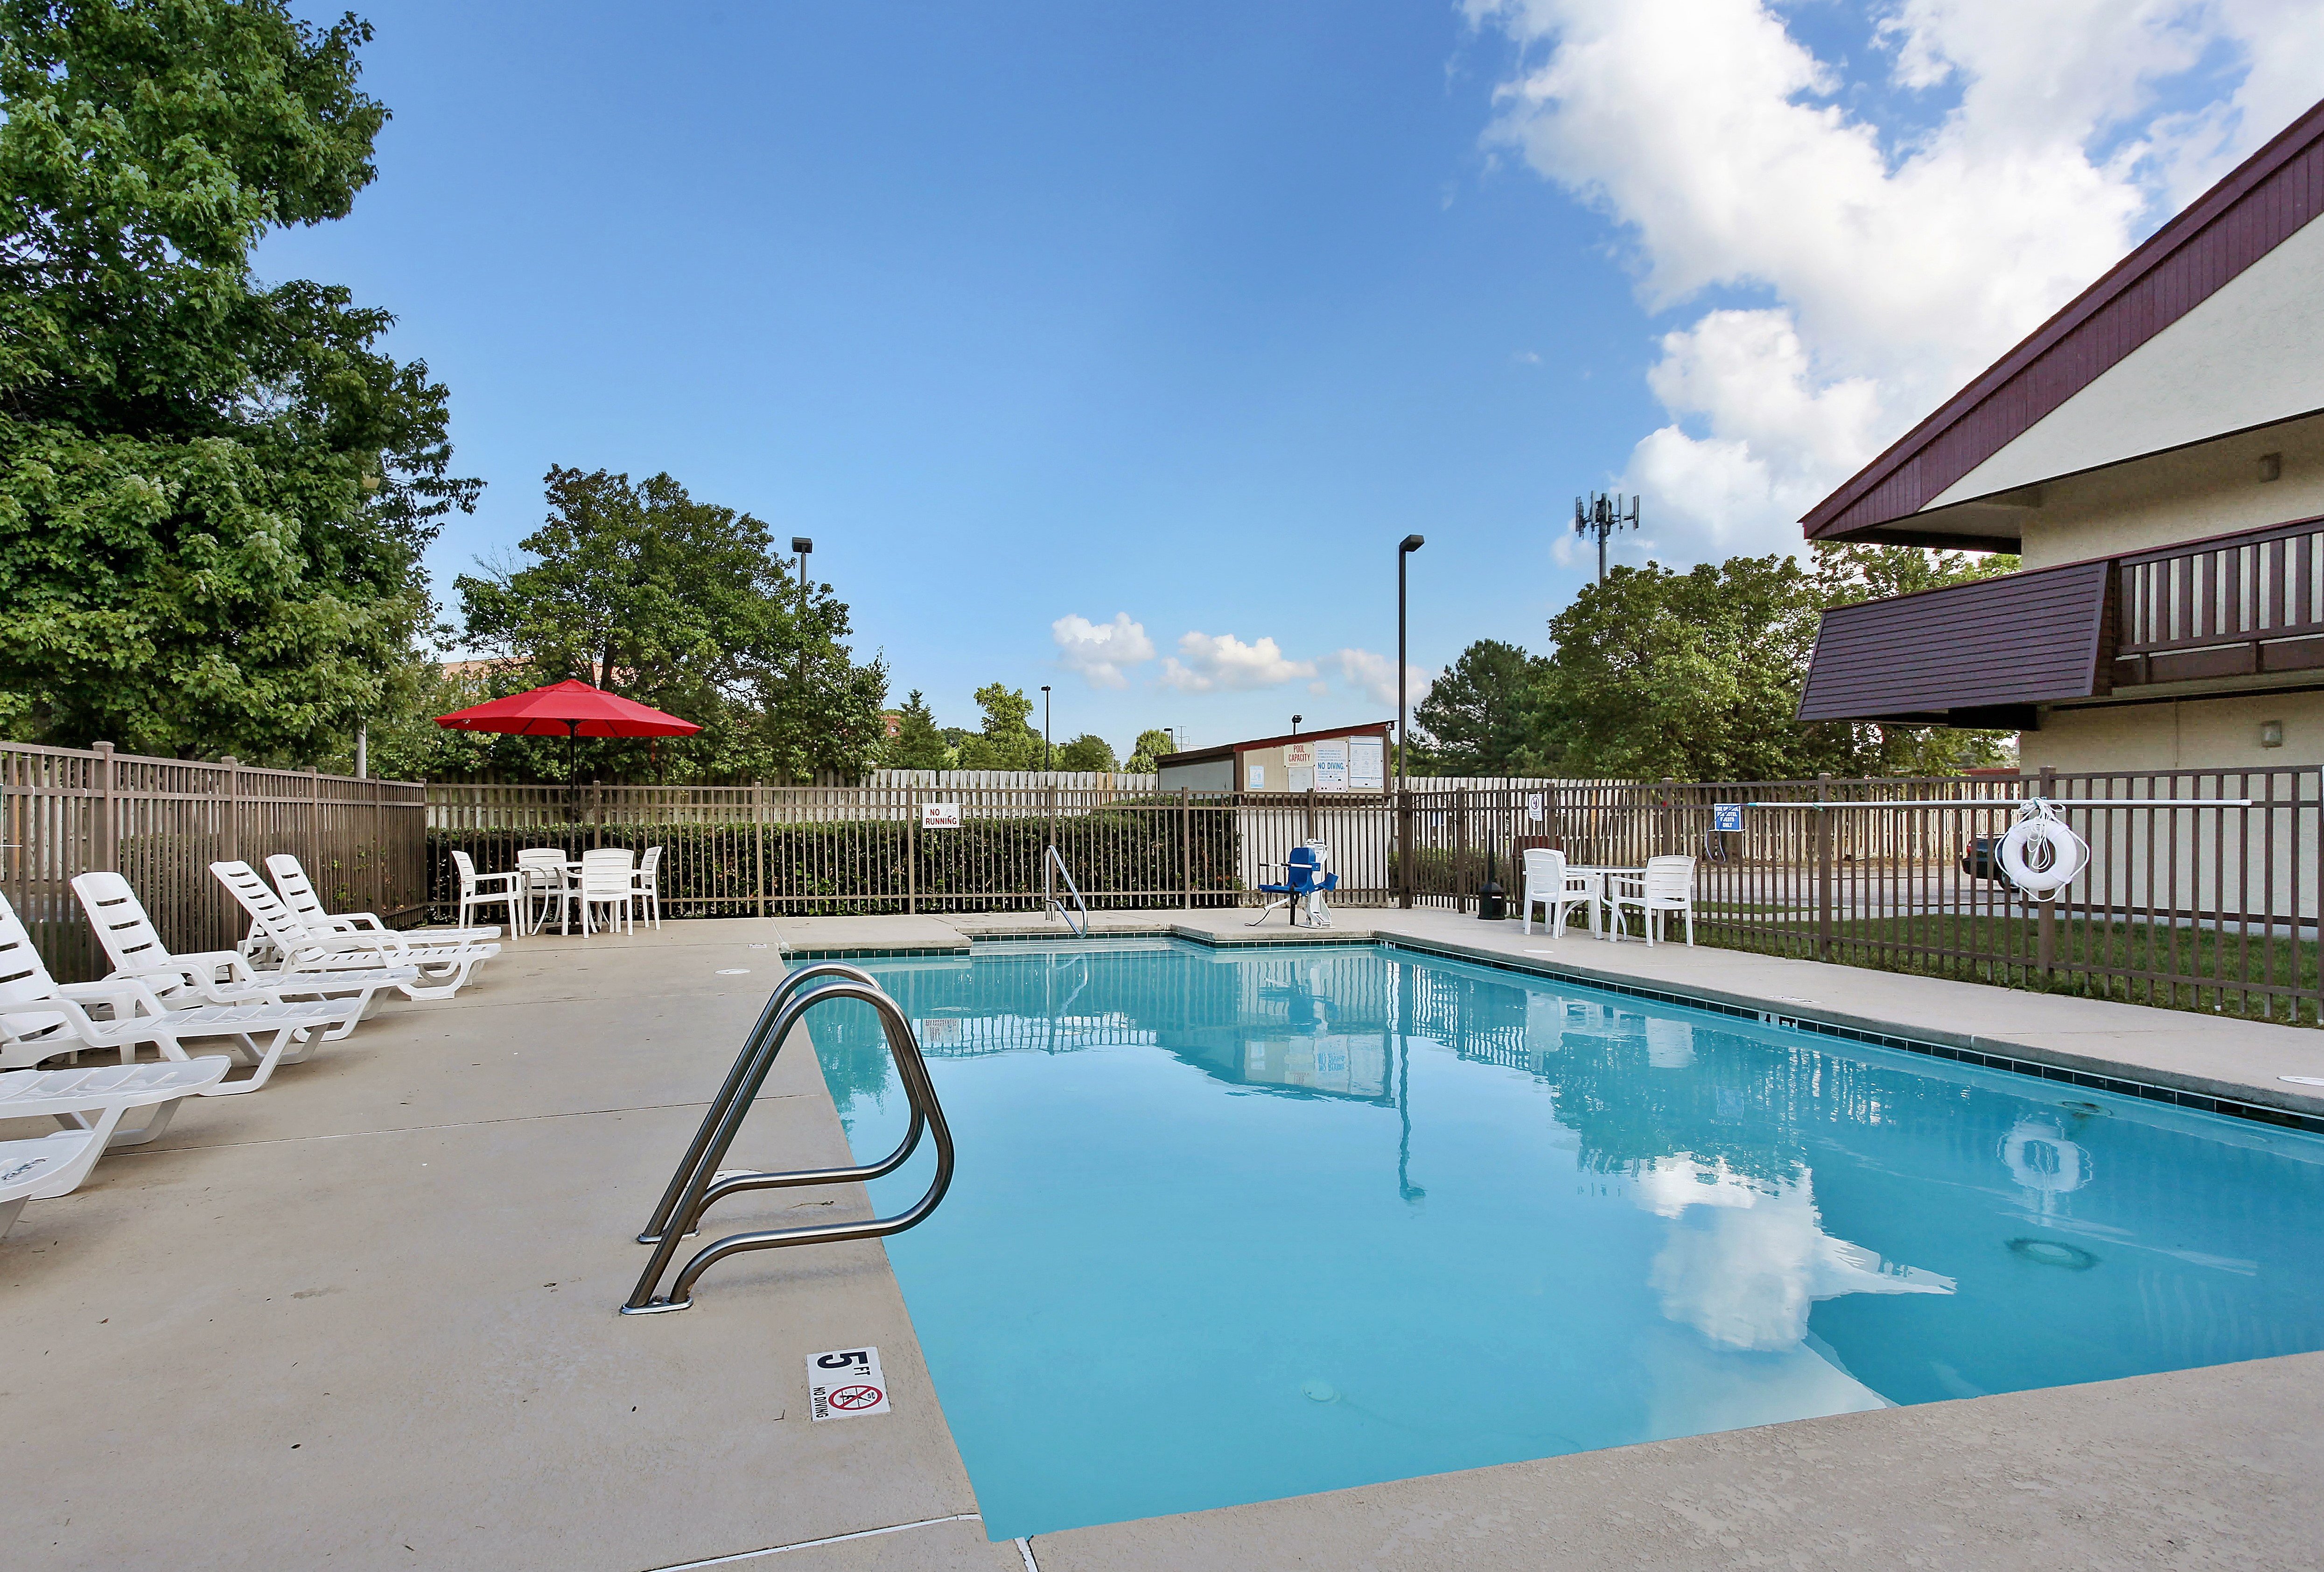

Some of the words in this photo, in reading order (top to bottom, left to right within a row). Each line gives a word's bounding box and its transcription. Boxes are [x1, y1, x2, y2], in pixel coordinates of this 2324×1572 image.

[1288, 754, 1310, 762] CAPACITY
[817, 1351, 868, 1369] 5
[854, 1366, 871, 1376] FT
[813, 1386, 826, 1396] NO
[814, 1397, 829, 1418] DIVING
